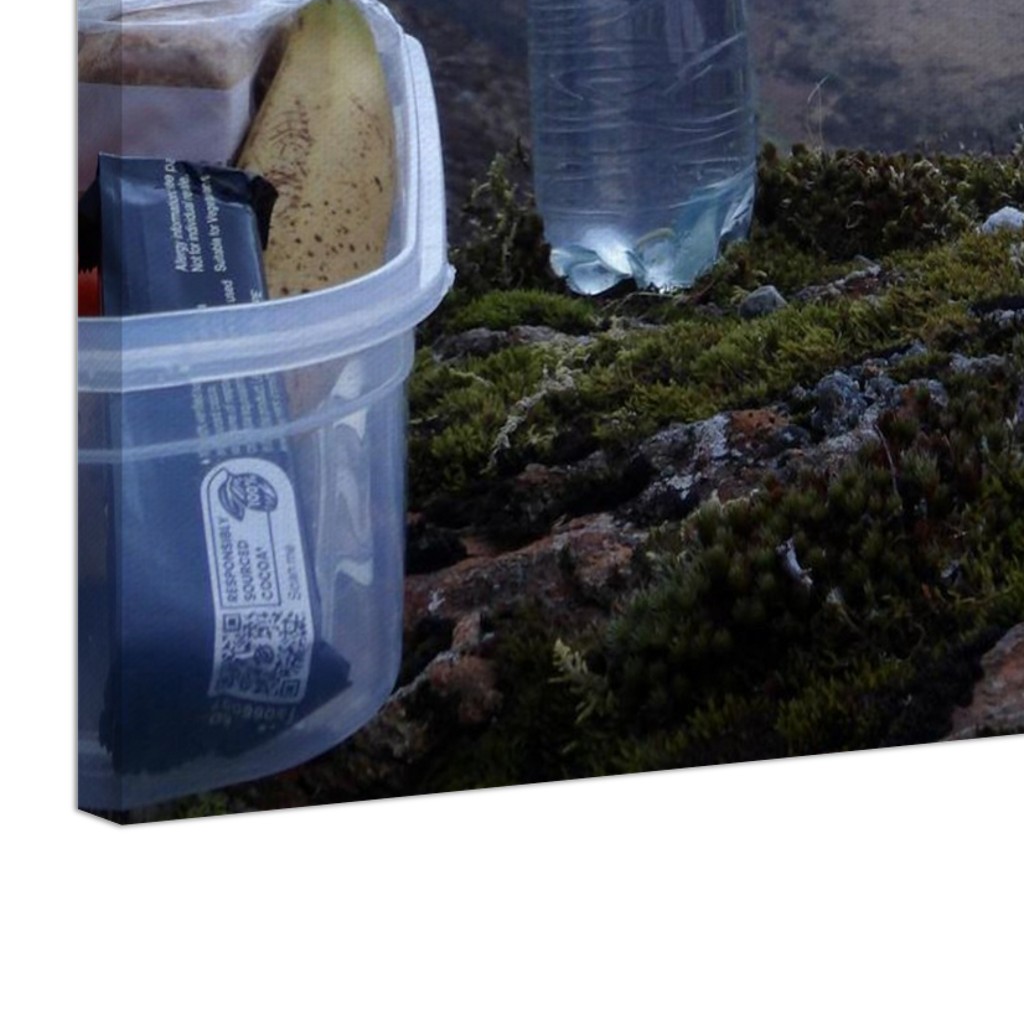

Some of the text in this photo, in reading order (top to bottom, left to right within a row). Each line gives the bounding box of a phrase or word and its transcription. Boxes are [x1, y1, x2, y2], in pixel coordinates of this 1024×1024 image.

[182, 200, 199, 242] individual
[208, 223, 221, 236] for
[173, 241, 190, 272] Allergy
[188, 243, 201, 255] for
[190, 255, 205, 272] Not
[211, 237, 228, 273] Suitable
[222, 279, 236, 303] used
[217, 515, 239, 603] RESPONSIBLY
[236, 539, 257, 602] SOURCED
